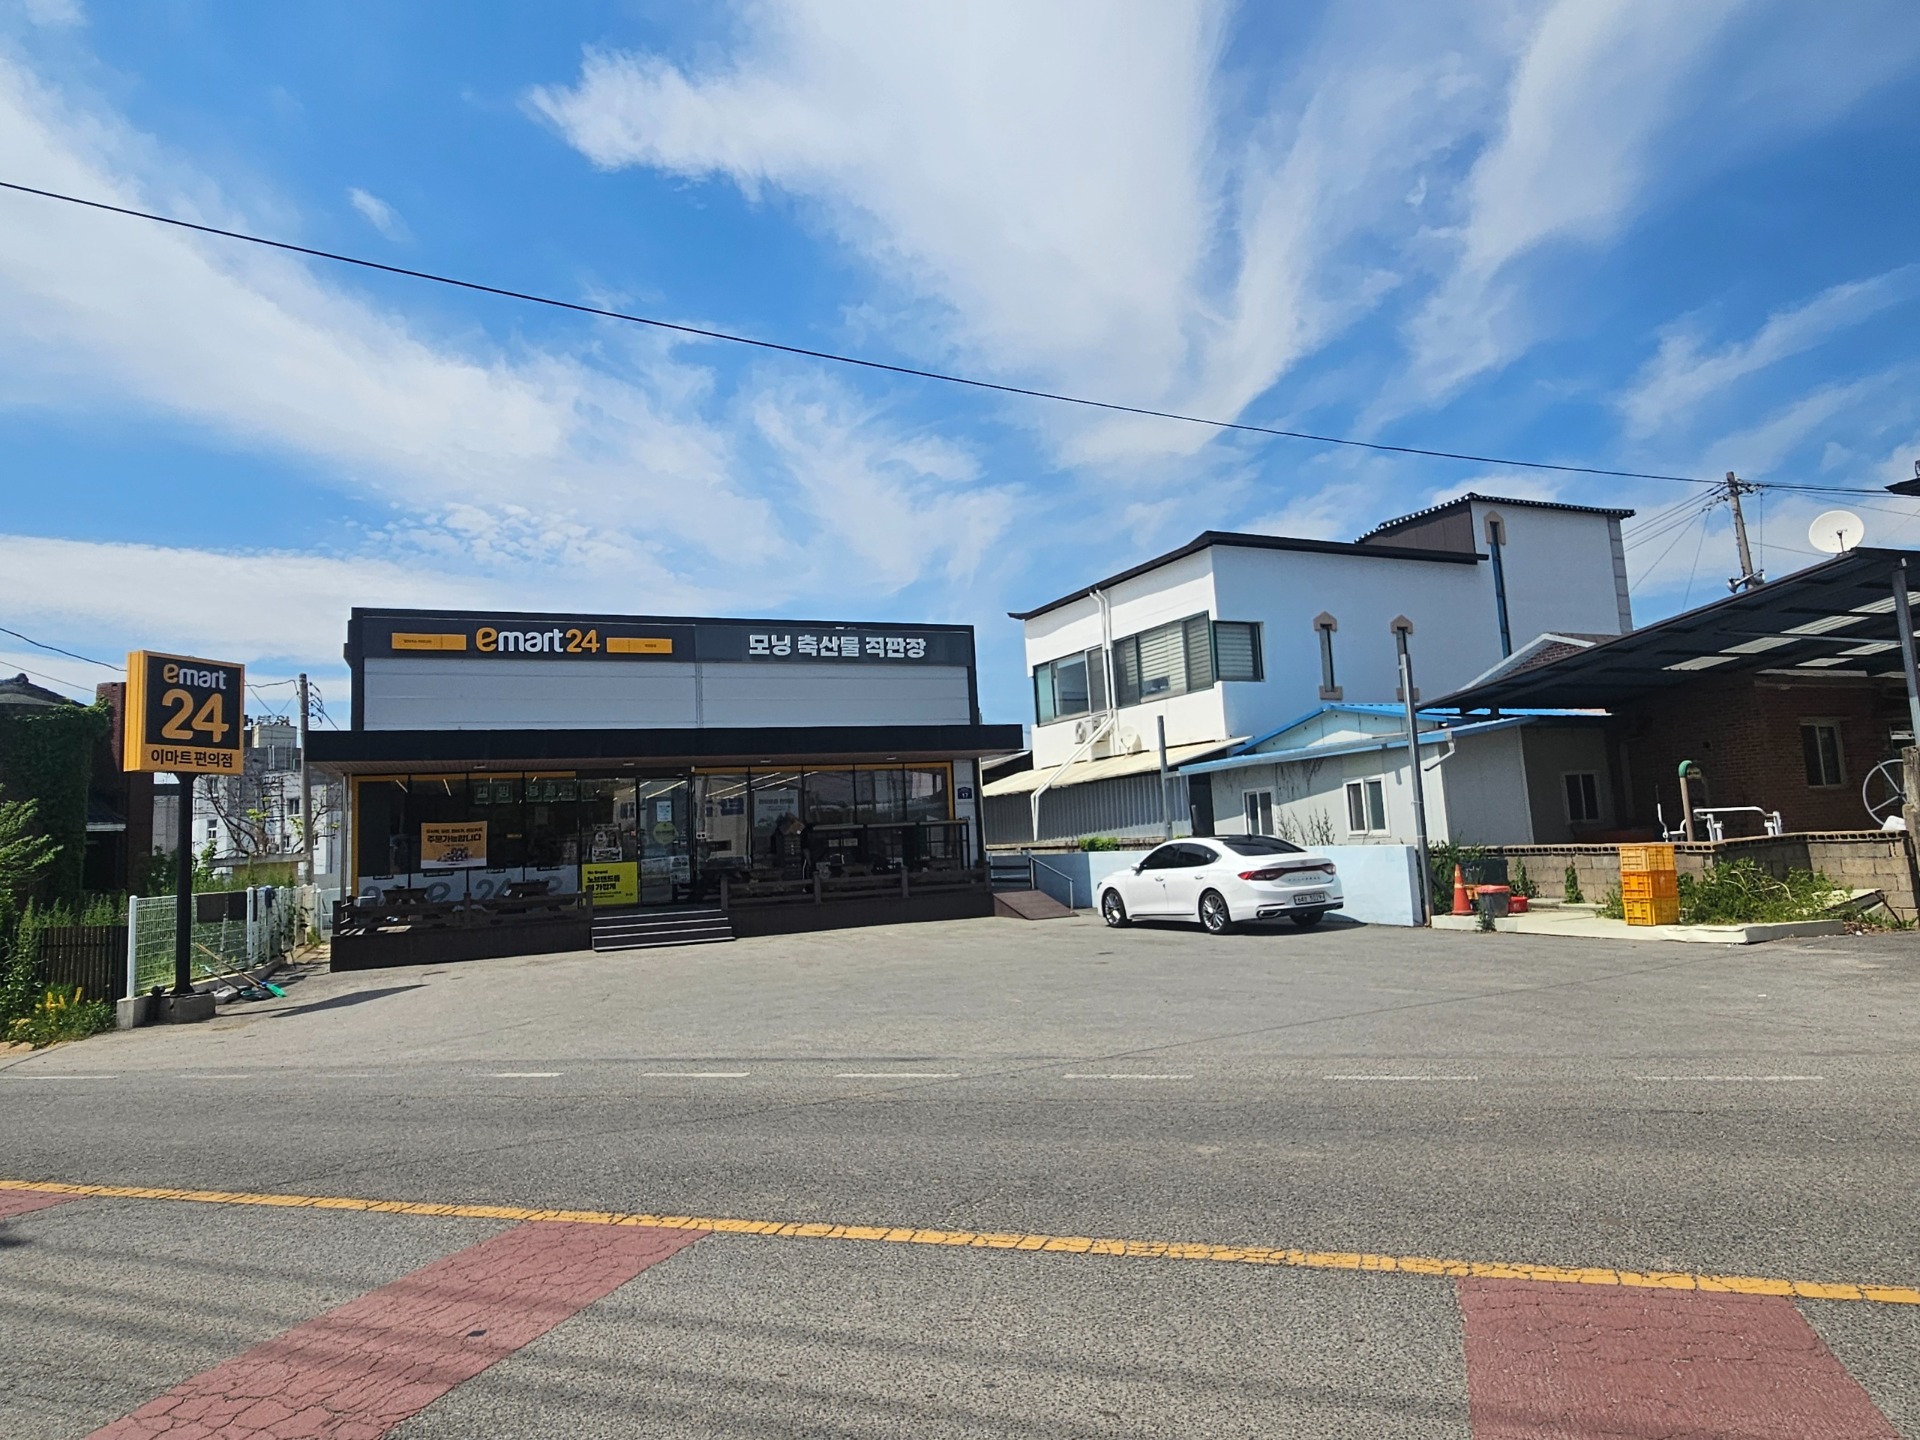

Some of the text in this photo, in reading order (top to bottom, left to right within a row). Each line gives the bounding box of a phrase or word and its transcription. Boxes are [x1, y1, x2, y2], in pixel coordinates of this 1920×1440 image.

[749, 634, 926, 658] 모닝 축산물 직판장
[163, 664, 227, 690] emart
[161, 688, 230, 743] 24
[151, 749, 233, 768] 이마트 편의점
